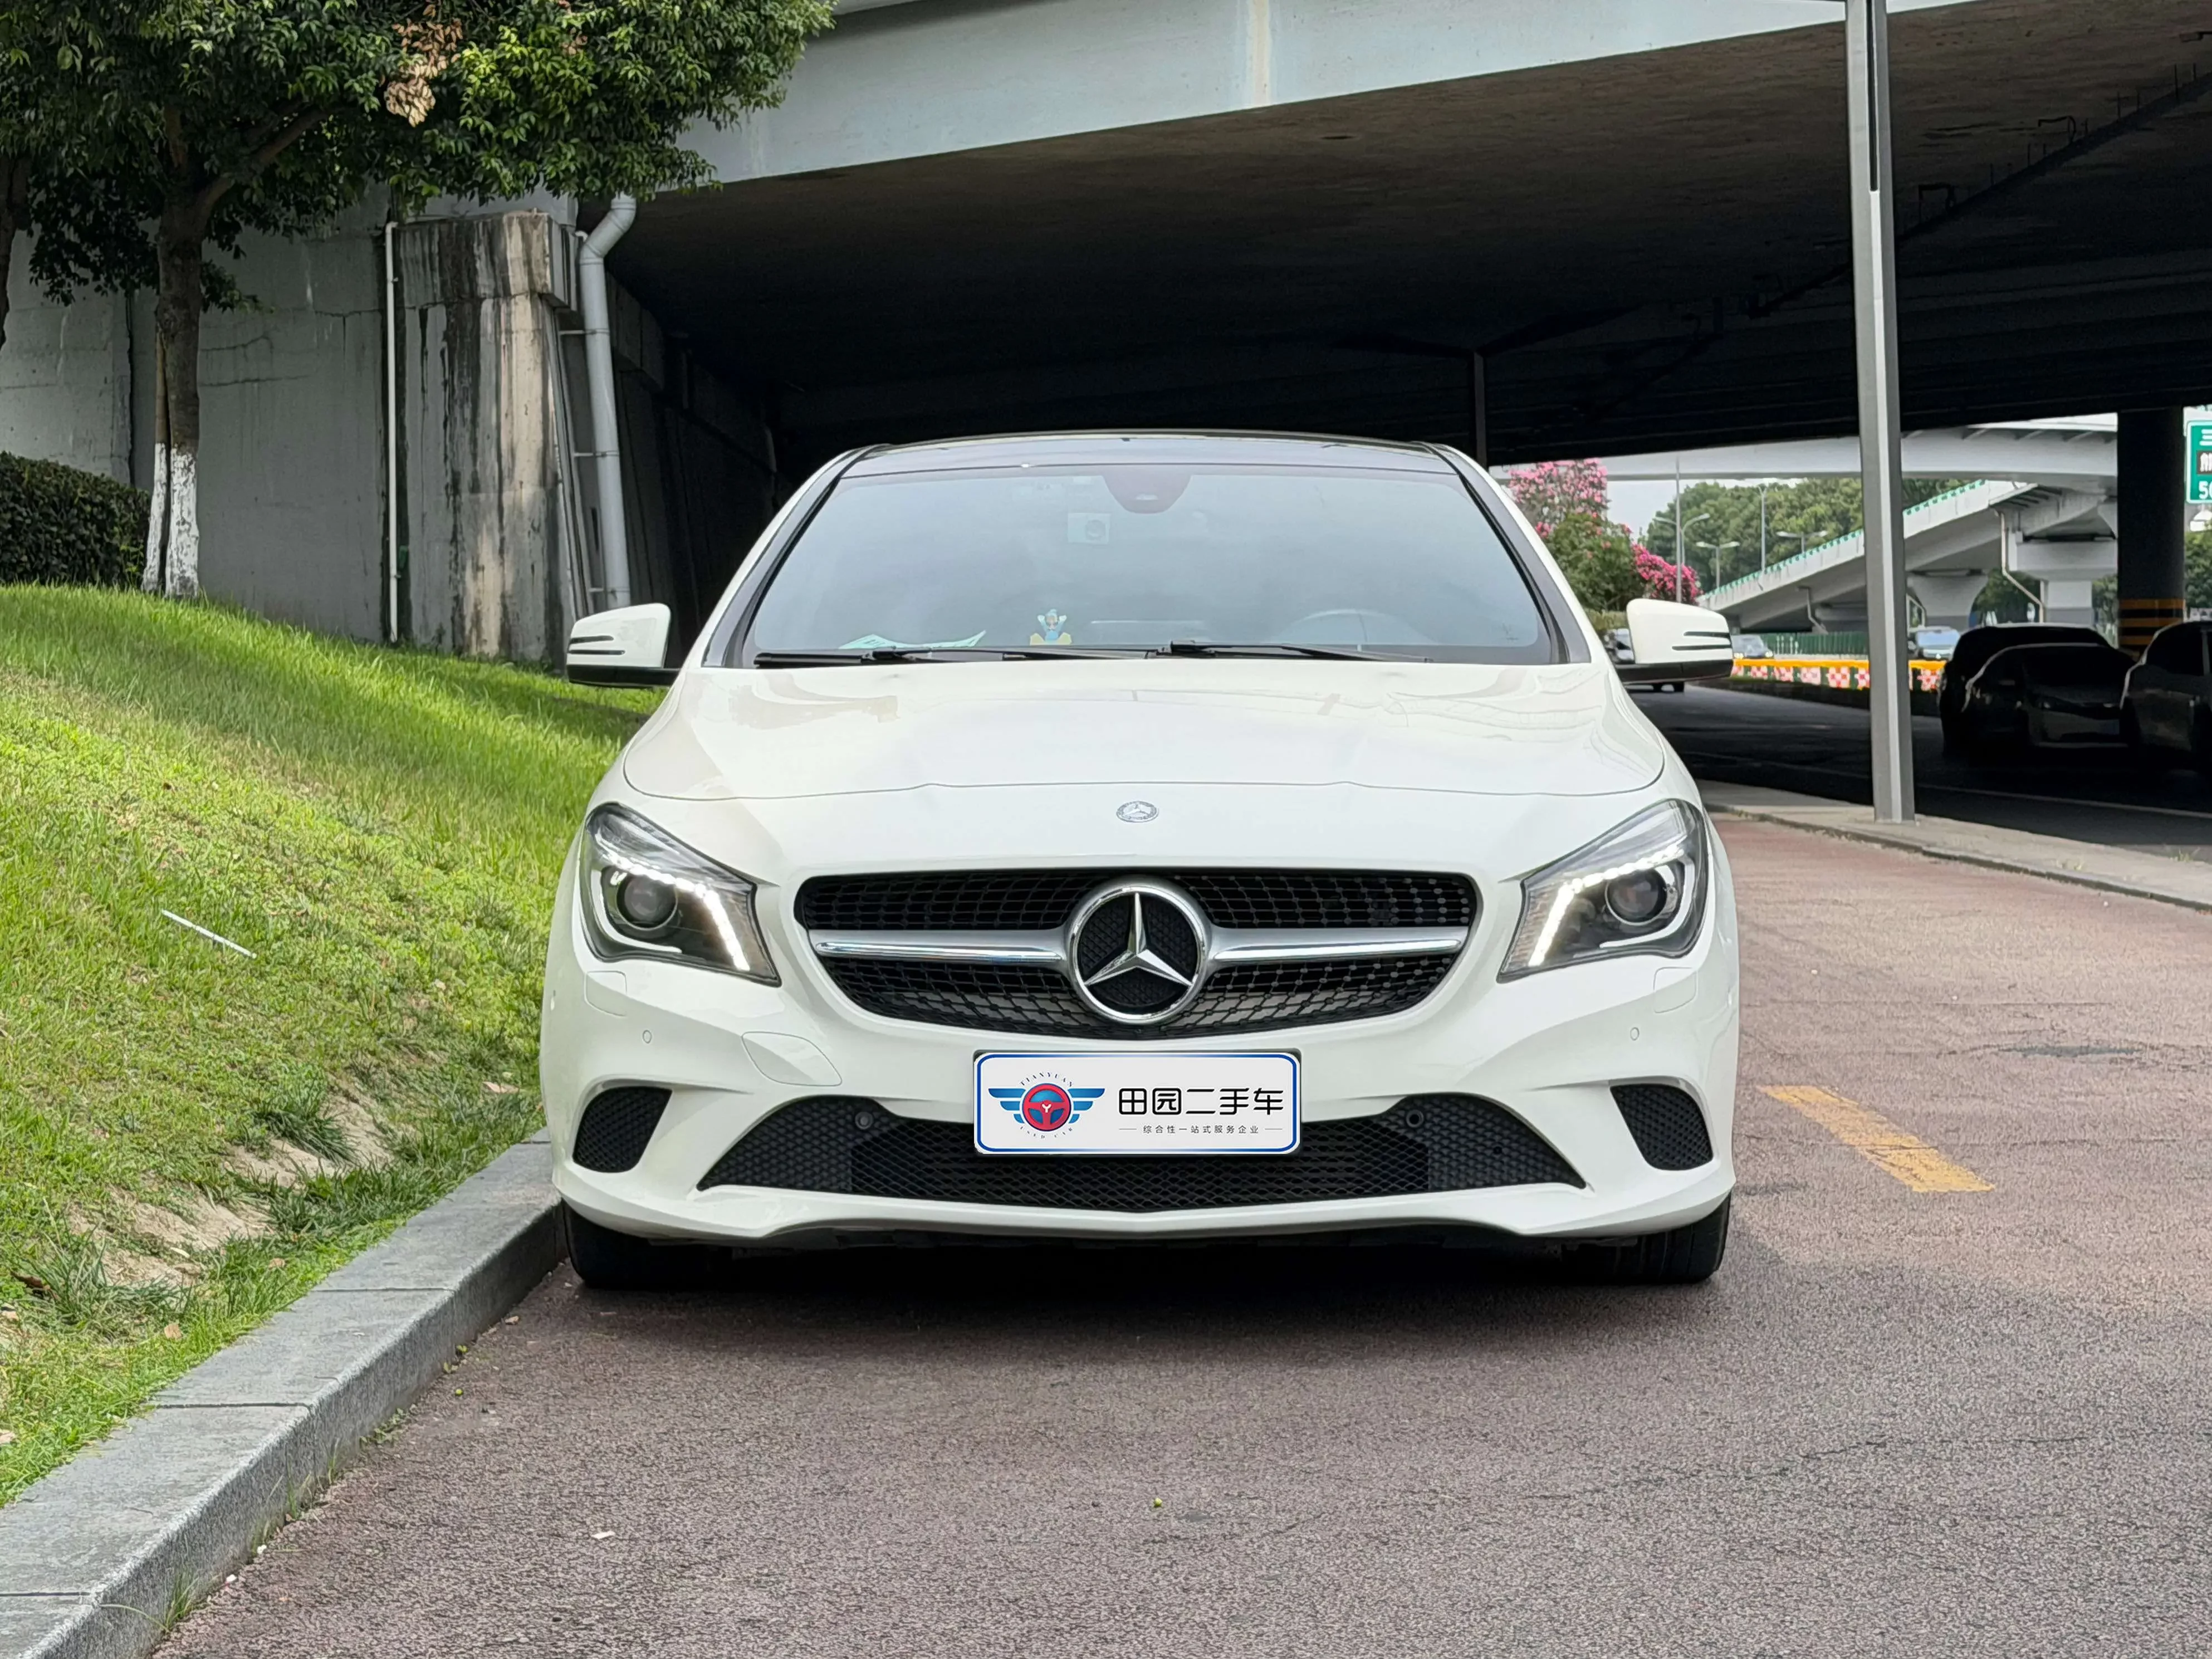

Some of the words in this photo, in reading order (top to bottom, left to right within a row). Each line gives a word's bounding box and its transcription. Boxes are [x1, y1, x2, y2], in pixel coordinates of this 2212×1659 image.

[1119, 1088, 1284, 1115] 田园二手车
[1143, 1125, 1259, 1134] 综合性一站式服务企业
